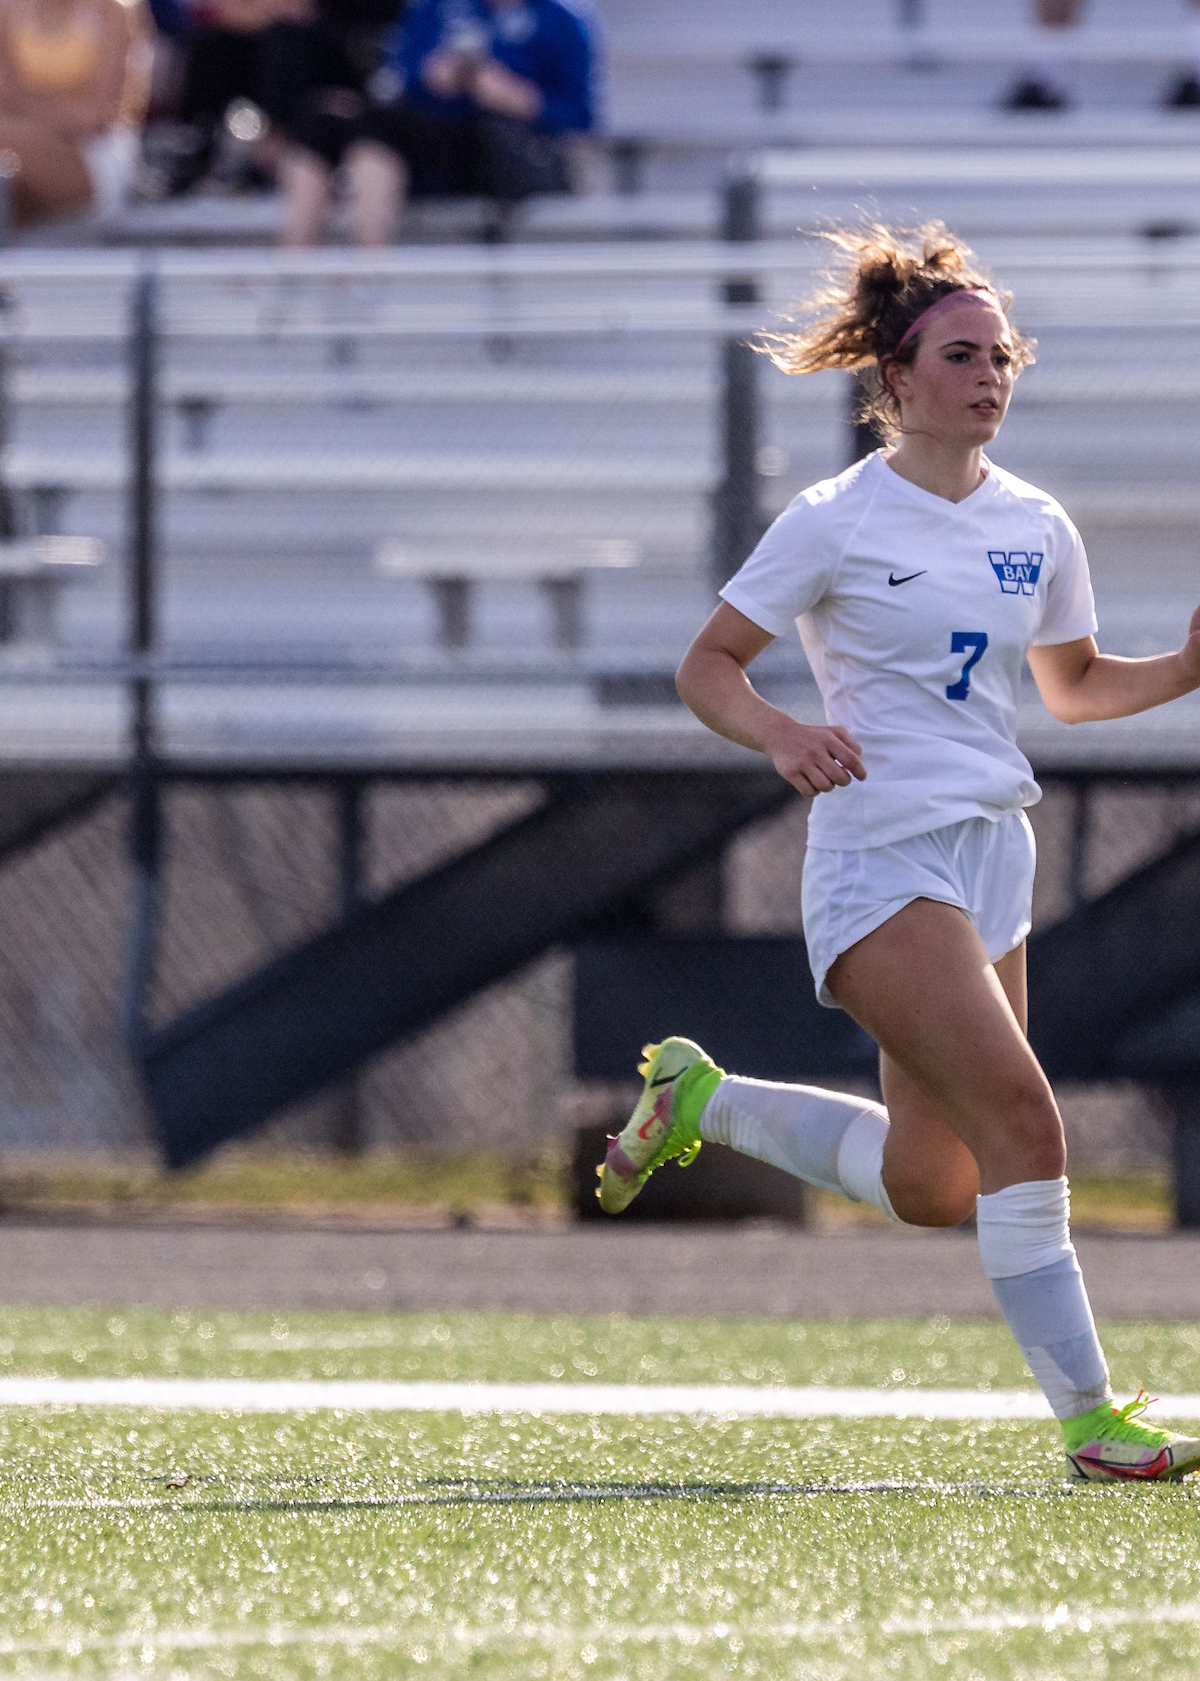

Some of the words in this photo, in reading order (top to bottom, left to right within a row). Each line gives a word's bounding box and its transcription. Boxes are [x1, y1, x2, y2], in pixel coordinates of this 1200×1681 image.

[987, 551, 1044, 596] W
[1003, 565, 1033, 582] BAY
[945, 632, 988, 701] 7
